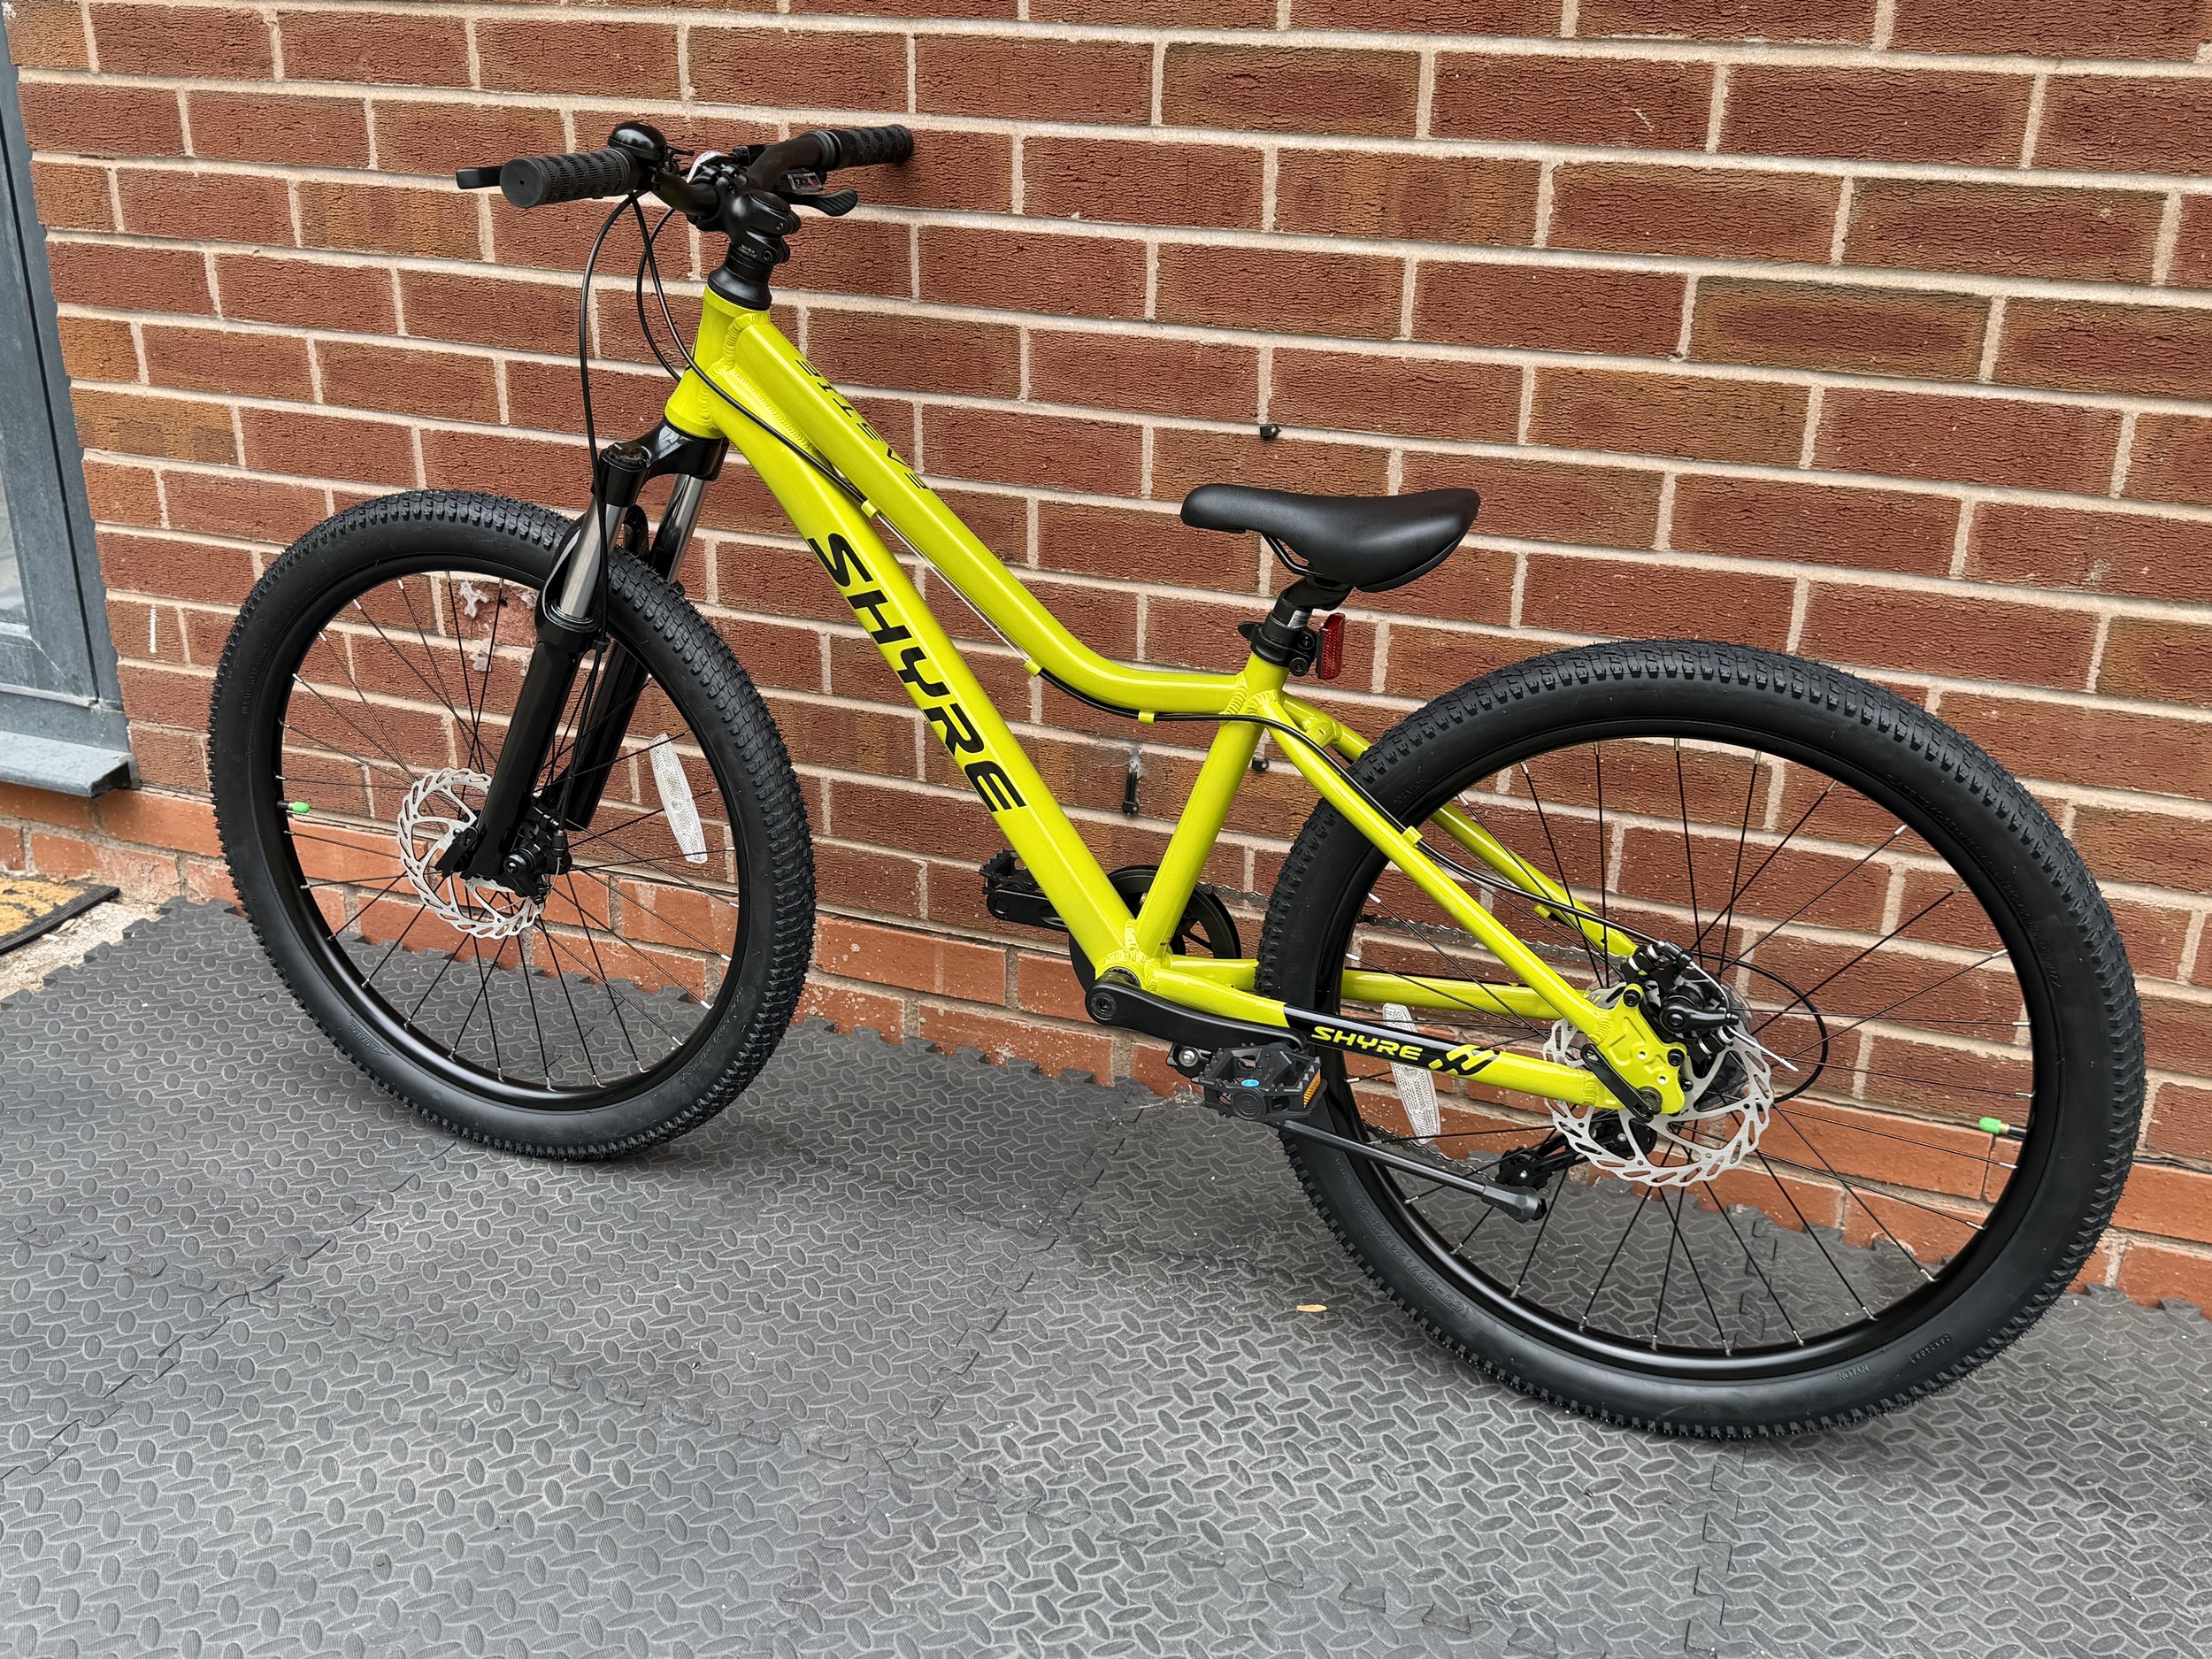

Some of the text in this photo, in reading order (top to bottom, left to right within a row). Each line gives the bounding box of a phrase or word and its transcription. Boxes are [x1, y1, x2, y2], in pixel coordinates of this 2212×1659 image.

[806, 533, 1027, 812] SHYRE
[1311, 1025, 1424, 1061] SHYRE
[1837, 1363, 1870, 1382] NYLON
